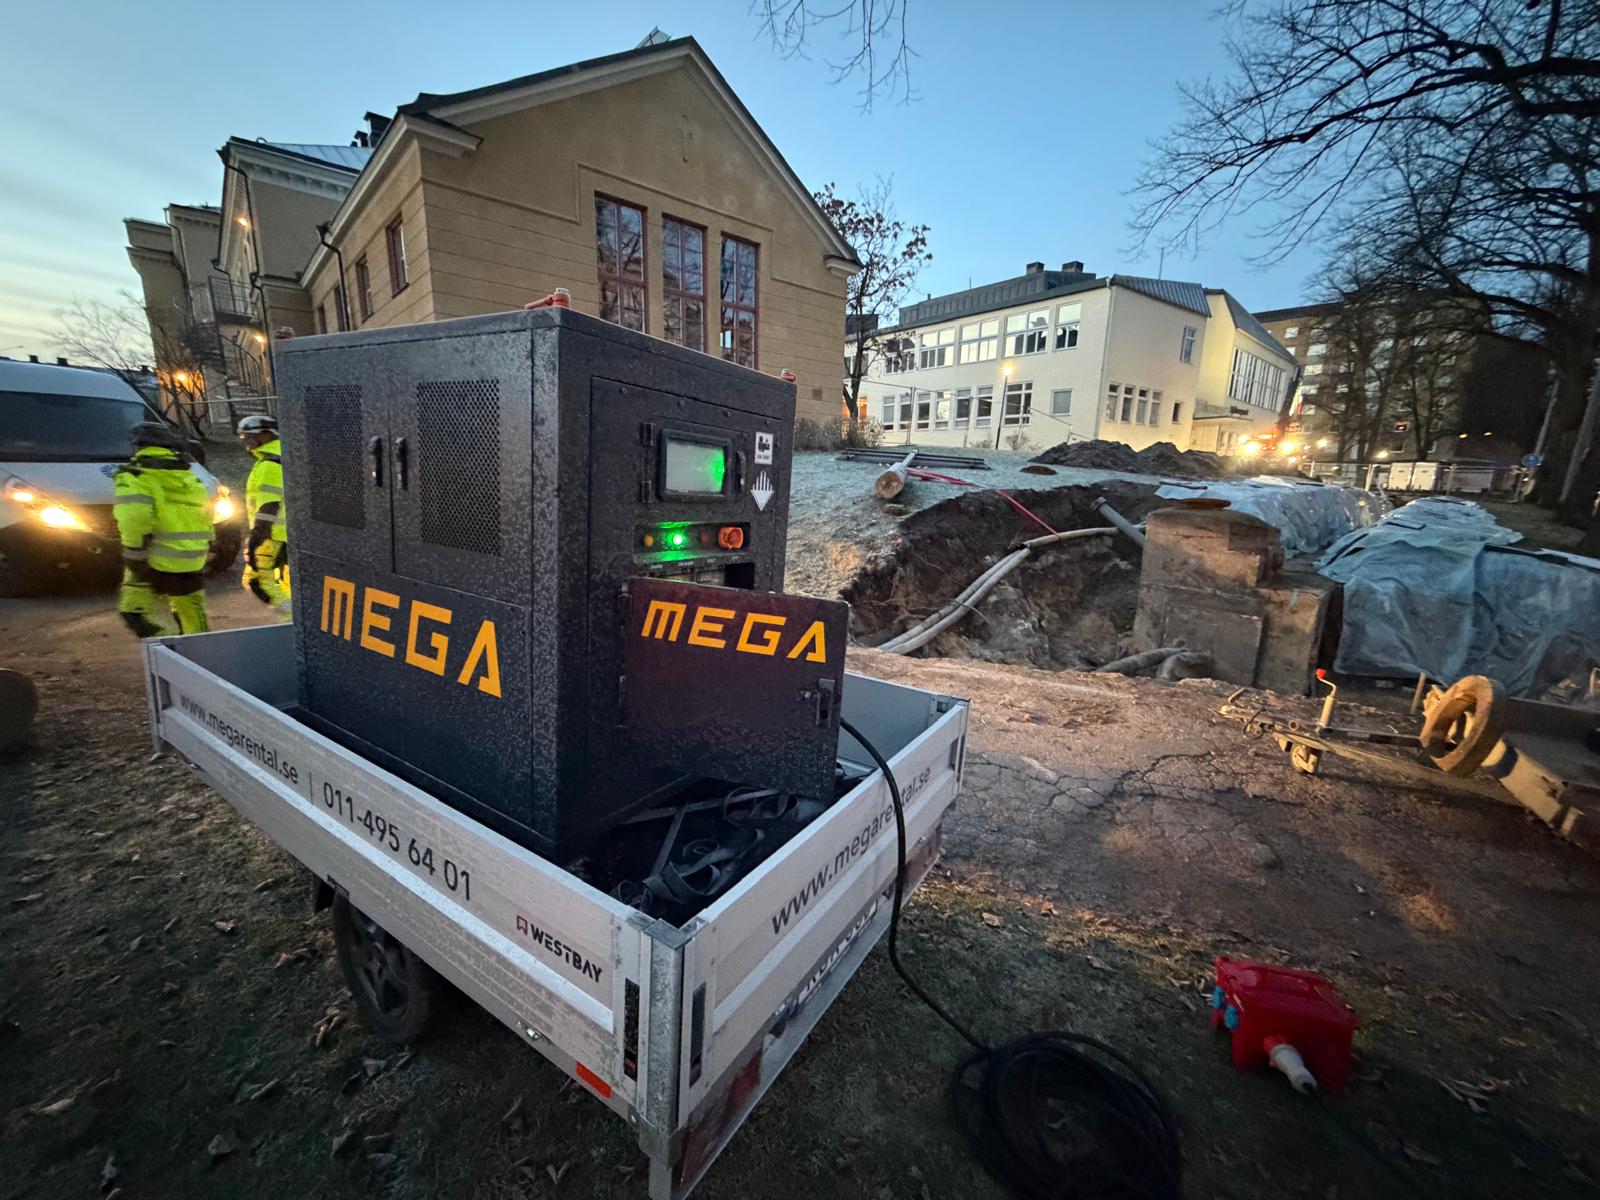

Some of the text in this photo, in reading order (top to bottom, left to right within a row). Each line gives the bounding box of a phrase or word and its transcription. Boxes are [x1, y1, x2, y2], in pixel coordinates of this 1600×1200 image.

[321, 575, 502, 698] MEGA
[641, 600, 826, 663] MEGA
[180, 695, 470, 901] www.megarental.se 011-495 64 01
[771, 767, 932, 935] www.megaretal.se
[530, 923, 602, 984] WESTBAY
